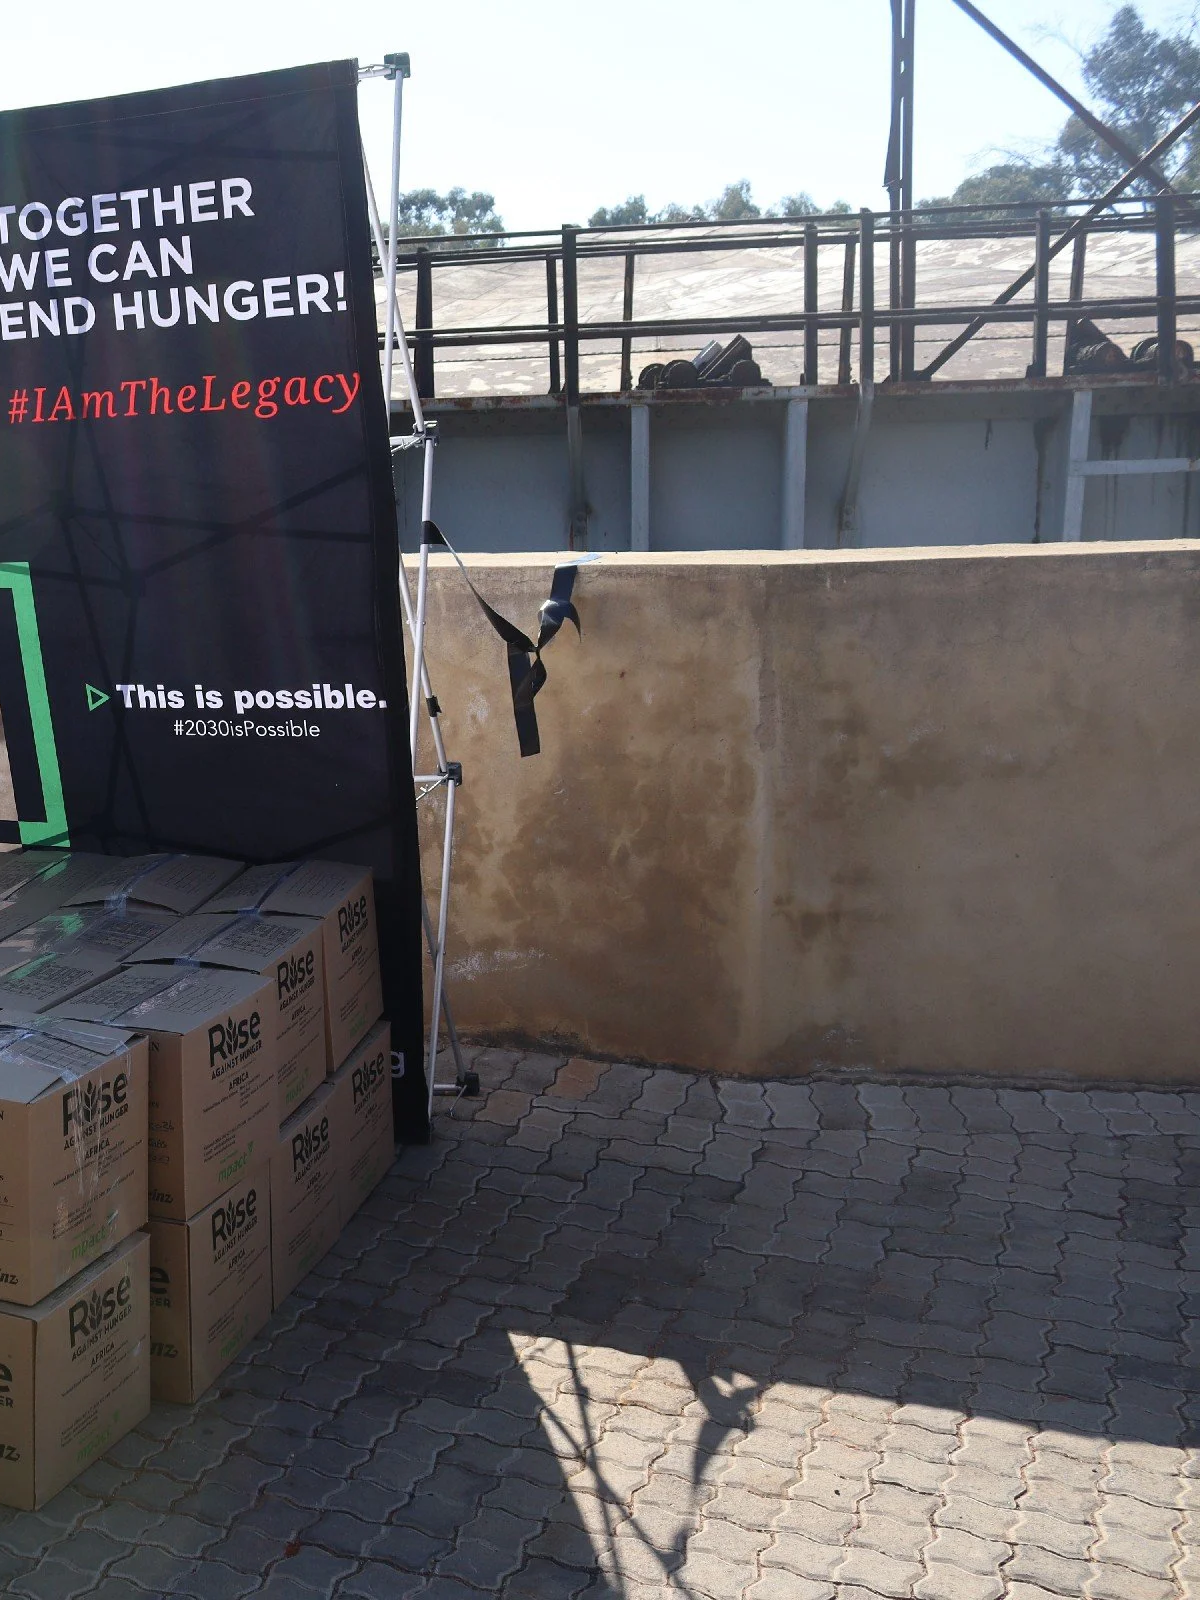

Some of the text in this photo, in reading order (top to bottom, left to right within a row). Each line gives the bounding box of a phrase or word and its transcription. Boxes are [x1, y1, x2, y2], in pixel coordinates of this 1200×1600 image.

[88, 235, 194, 283] CAN
[0, 271, 347, 341] END HUNGER!
[8, 371, 361, 424] #IAmTheLegacy
[116, 684, 388, 714] This is possible.
[174, 720, 321, 737] #2030isPossible
[211, 1053, 238, 1081] AGAINST
[239, 1039, 263, 1064] HUNGER
[228, 1071, 249, 1092] AFRICA
[100, 1103, 129, 1131] HUNGER
[85, 1137, 111, 1161] AFRICA
[213, 1234, 235, 1264] AGAINST
[237, 1215, 258, 1242] HUNGER
[228, 1248, 246, 1270] AFRICA
[71, 1303, 132, 1362] AGAINST HUNGER
[90, 1341, 115, 1368] AFRICA
